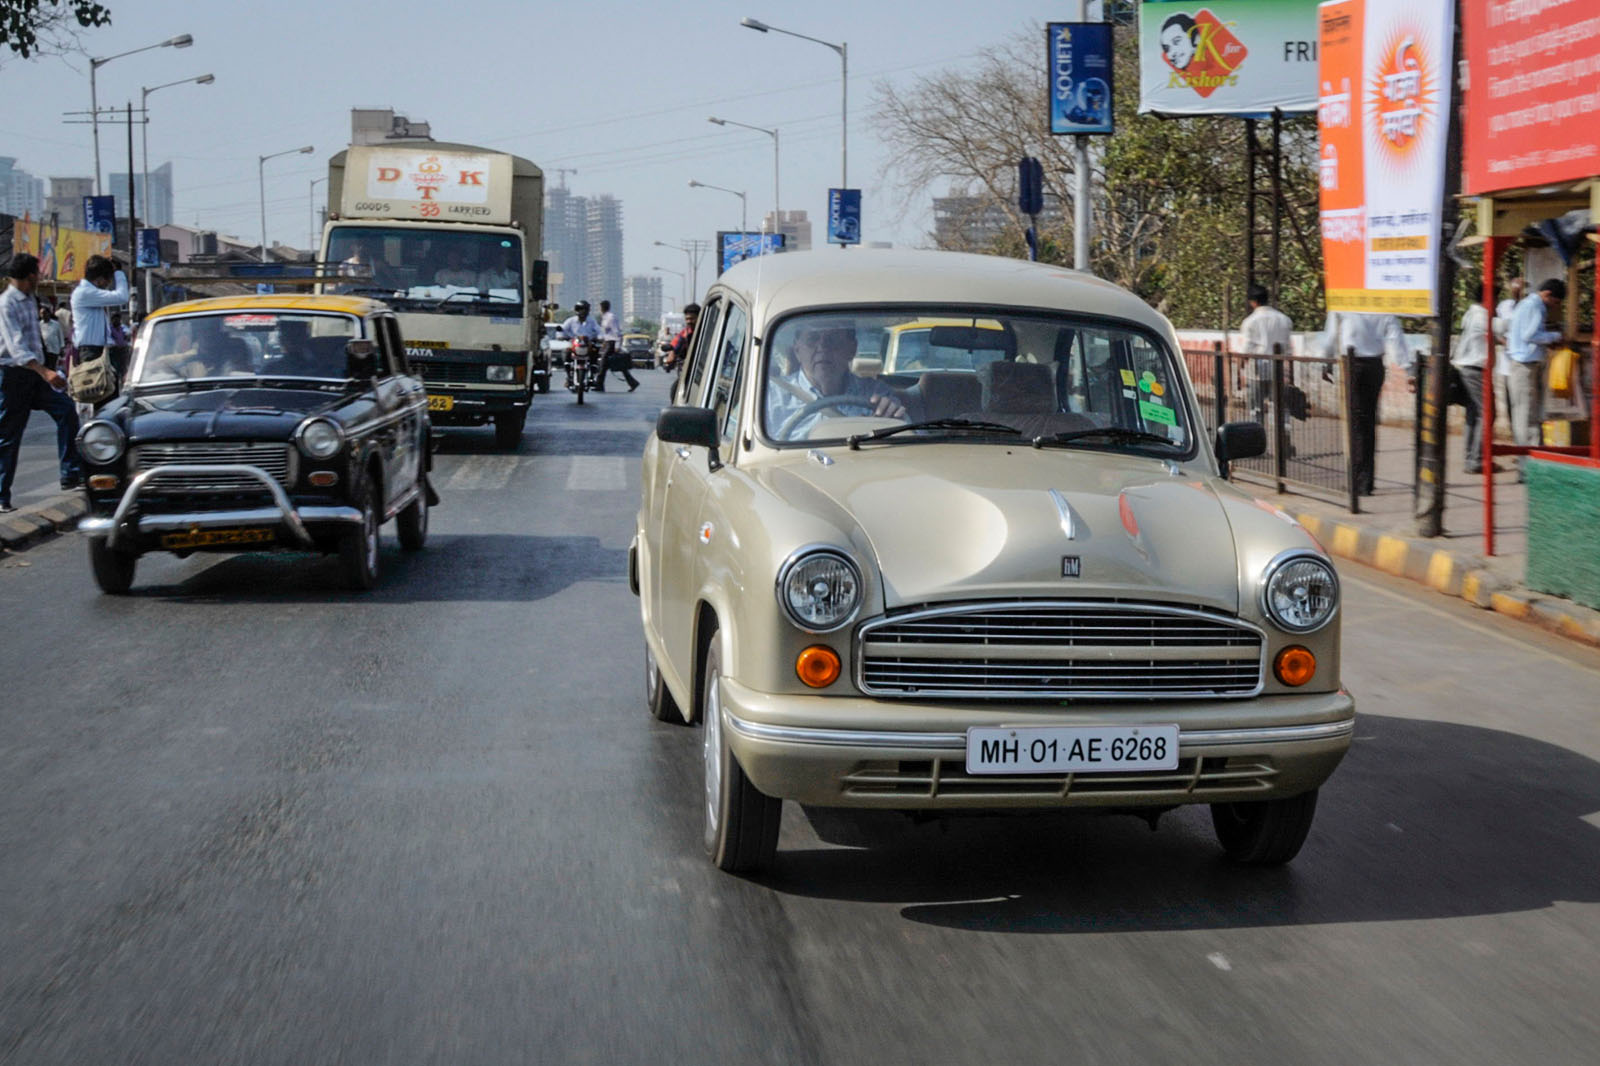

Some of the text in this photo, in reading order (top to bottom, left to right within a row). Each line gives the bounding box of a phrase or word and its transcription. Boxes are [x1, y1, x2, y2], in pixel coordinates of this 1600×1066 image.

[1056, 28, 1073, 100] SOCIETY
[1167, 71, 1239, 89] Kishore
[377, 167, 402, 182] D
[458, 170, 484, 186] K
[416, 186, 439, 200] T
[355, 202, 391, 212] GOODS
[405, 347, 434, 357] TATA
[980, 736, 1166, 764] MH 01 AE 6268
